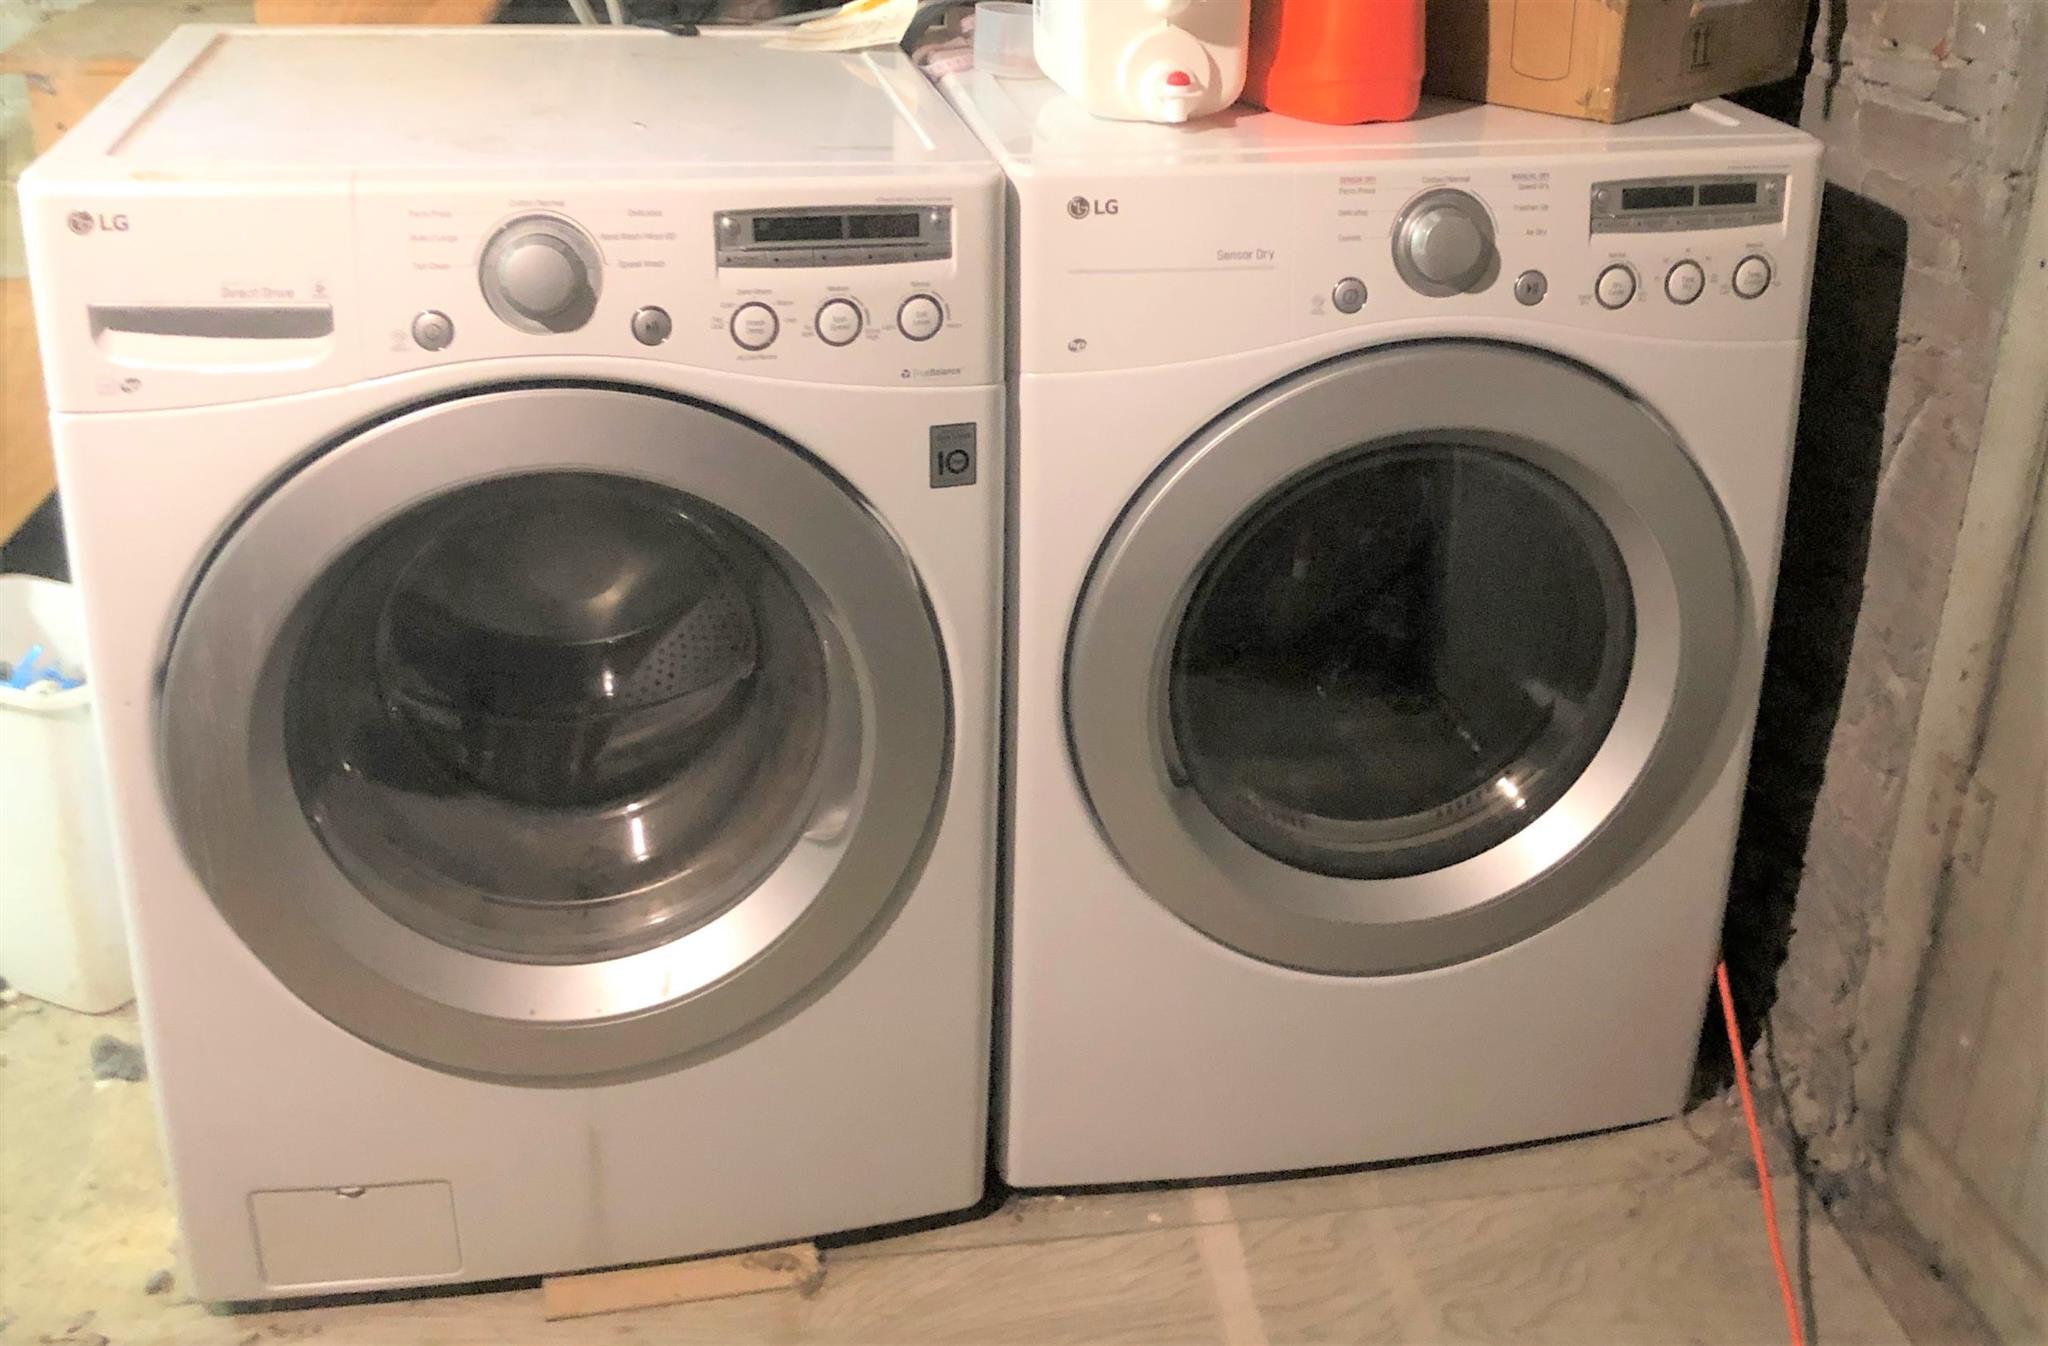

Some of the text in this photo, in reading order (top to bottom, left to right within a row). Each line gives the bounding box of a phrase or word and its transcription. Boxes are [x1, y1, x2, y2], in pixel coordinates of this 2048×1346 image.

[1094, 199, 1118, 215] LG
[99, 214, 129, 232] LG
[1216, 248, 1275, 261] Sensor Dry
